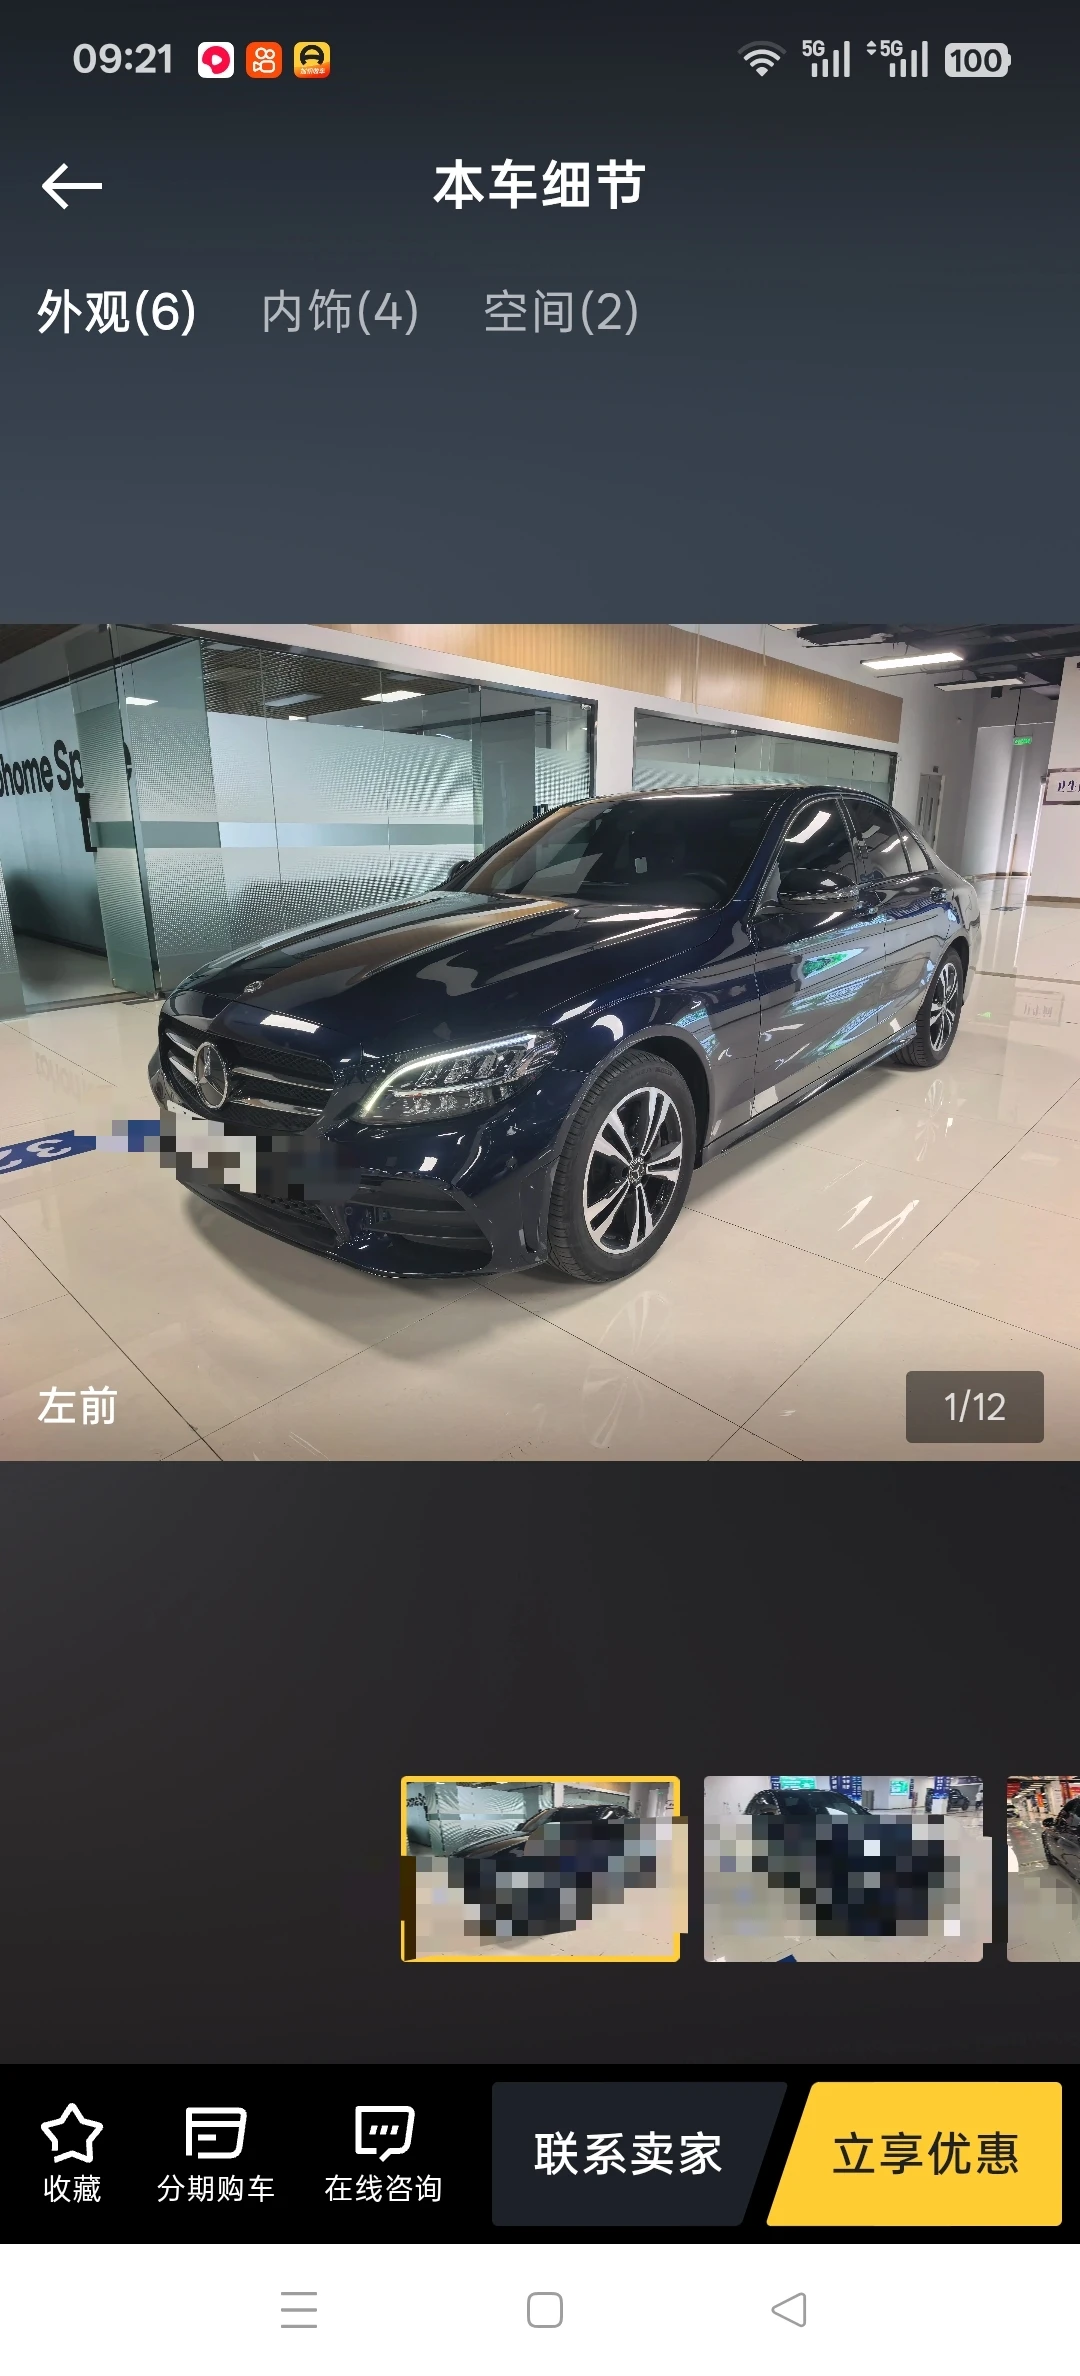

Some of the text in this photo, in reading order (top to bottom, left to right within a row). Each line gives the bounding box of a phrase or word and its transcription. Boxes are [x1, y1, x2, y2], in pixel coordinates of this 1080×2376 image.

[73, 43, 172, 74] 09:21
[801, 39, 826, 57] 5G
[879, 39, 904, 57] 5G
[950, 49, 1002, 72] 100
[433, 158, 646, 209] 本车细节
[37, 289, 196, 337] 外观(6)
[263, 289, 419, 337] 内饰(4)
[484, 289, 639, 337] 空间(2)
[0, 753, 53, 797] home
[1057, 779, 1080, 793] 卫生
[37, 1385, 118, 1425] 左前
[945, 1389, 1006, 1422] 1/12
[534, 2131, 723, 2175] 联系卖家
[832, 2131, 1020, 2175] 立享优惠
[43, 2173, 102, 2203] 收藏
[156, 2173, 275, 2203] 分期购车
[324, 2173, 443, 2203] 在线咨询
